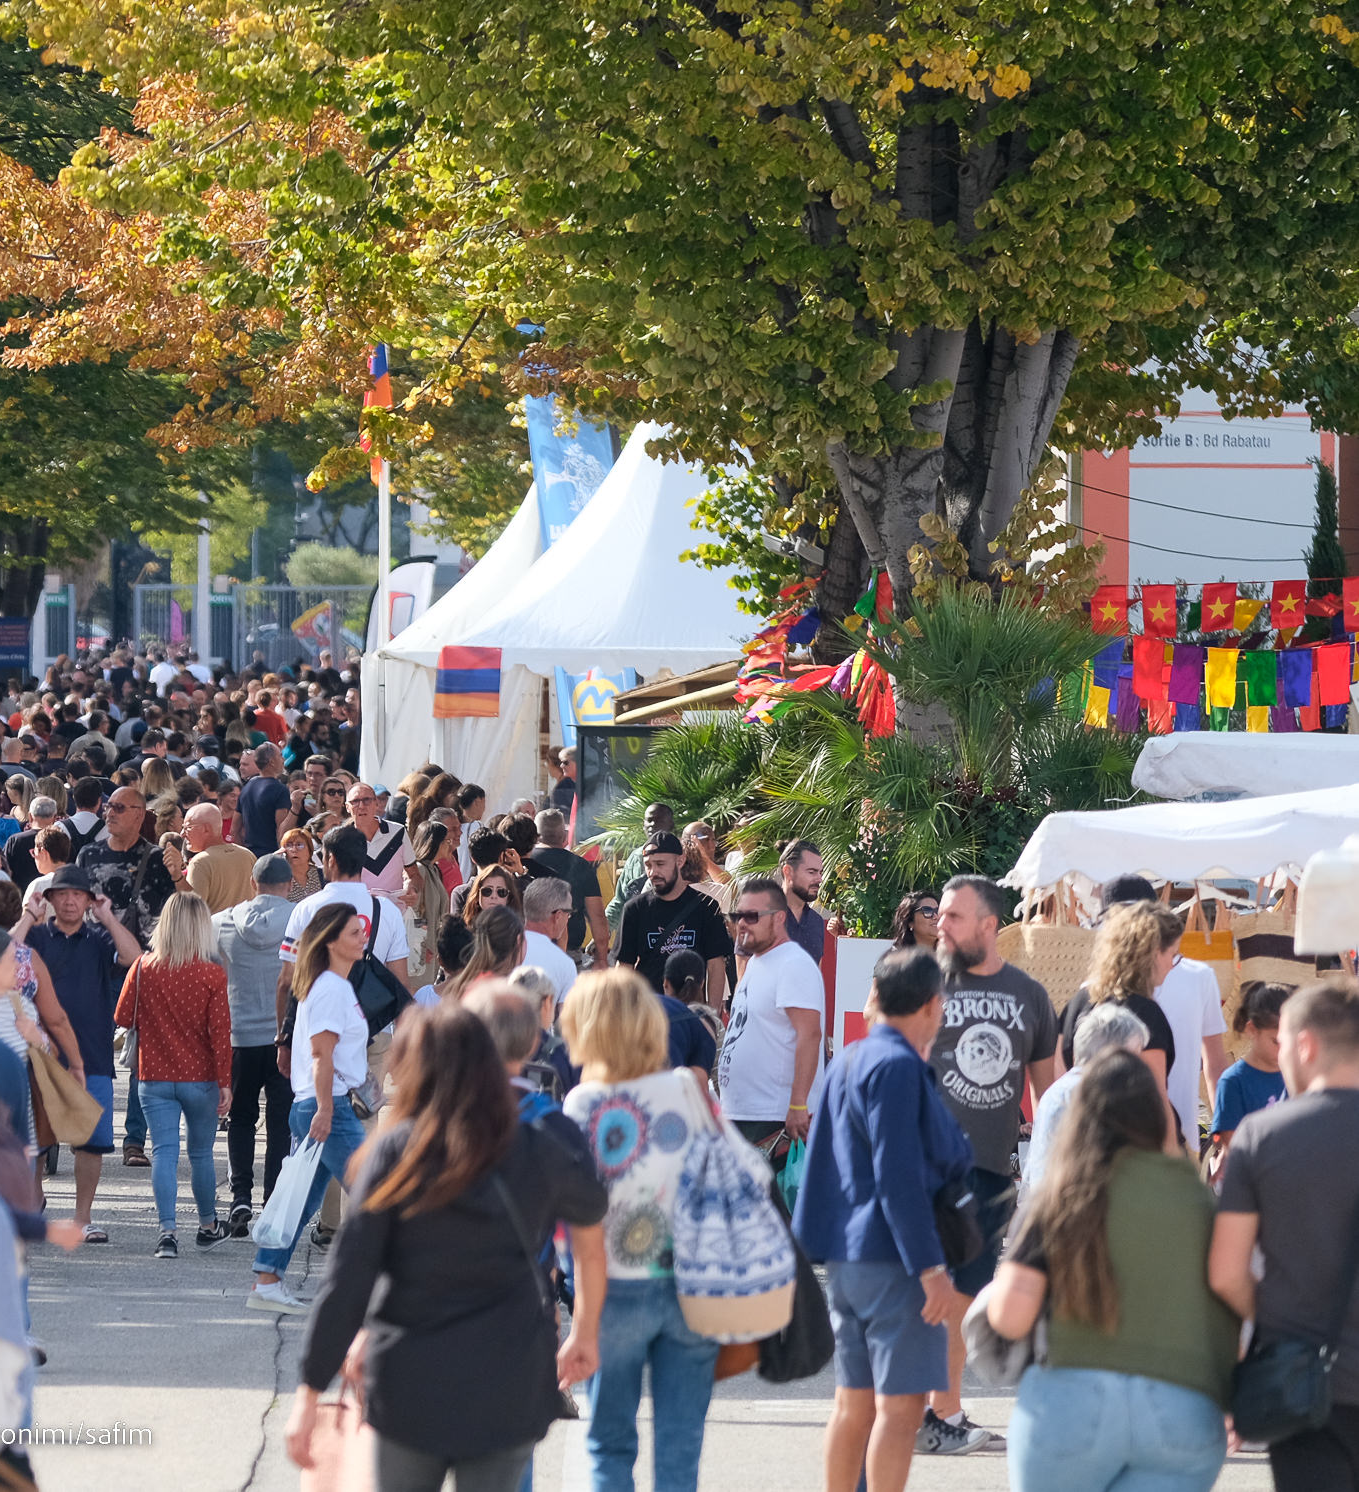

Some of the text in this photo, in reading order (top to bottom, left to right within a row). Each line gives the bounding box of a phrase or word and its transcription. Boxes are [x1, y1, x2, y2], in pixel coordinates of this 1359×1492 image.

[1142, 433, 1181, 447] Sortie
[1204, 433, 1218, 448] Bd
[1222, 434, 1271, 449] Rabatau
[942, 997, 1026, 1032] BRONX
[942, 1069, 1015, 1104] ORIGINALS
